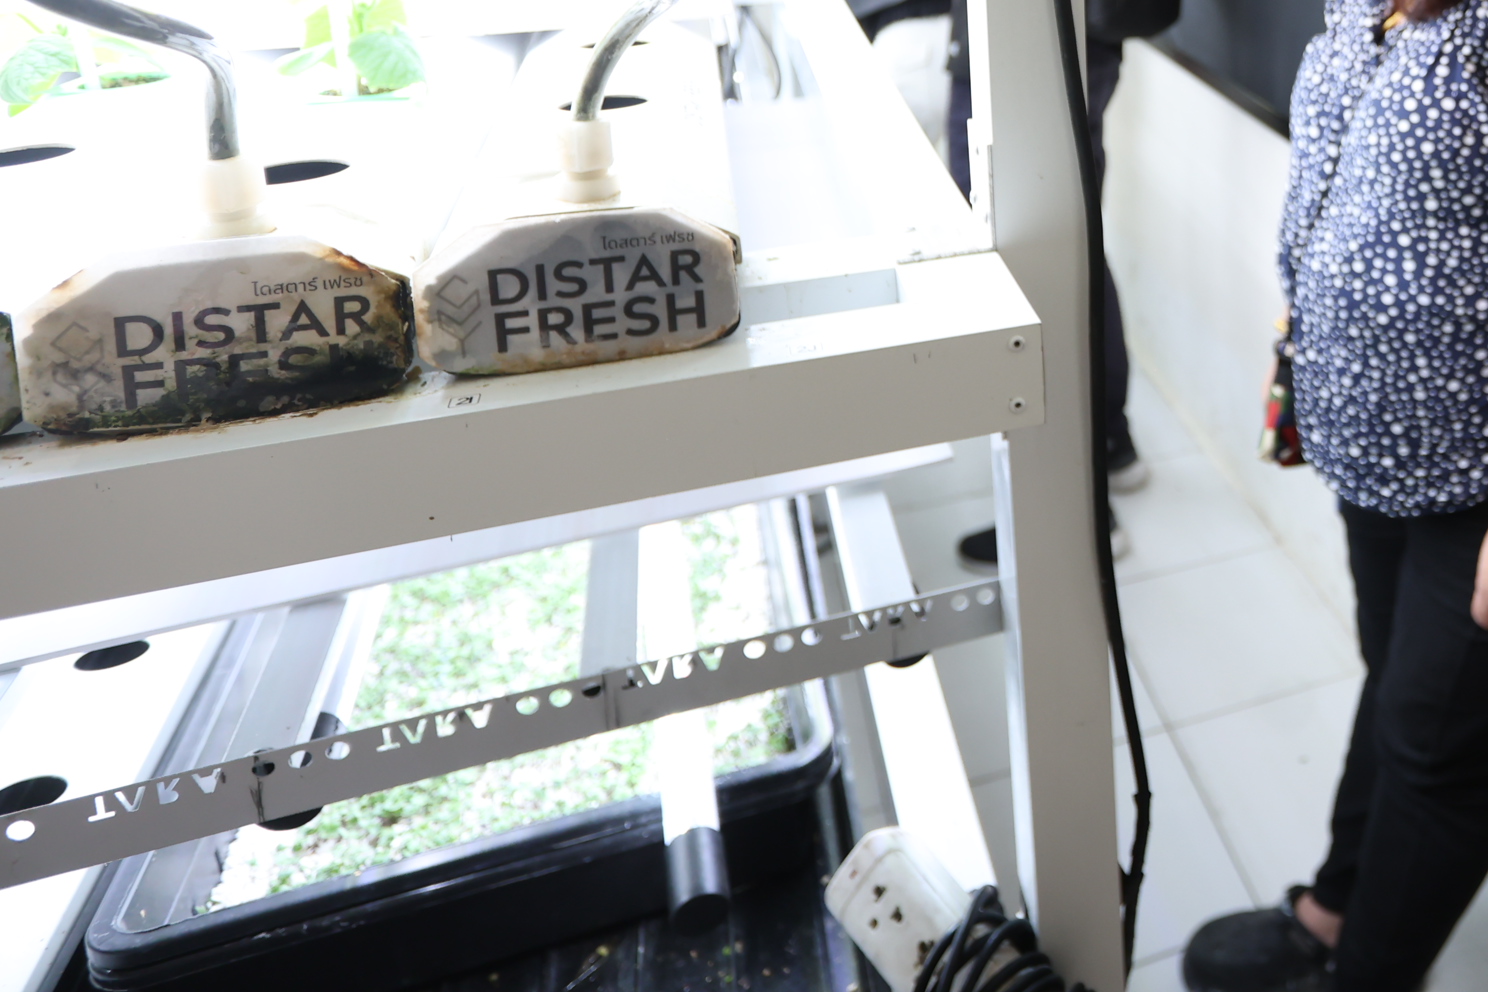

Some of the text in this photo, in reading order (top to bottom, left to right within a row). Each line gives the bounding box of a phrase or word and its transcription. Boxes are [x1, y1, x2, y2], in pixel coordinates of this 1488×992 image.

[601, 232, 656, 250] ไดสตาร์
[251, 277, 319, 296] ไดสตาร์
[487, 249, 703, 306] DISTAR
[113, 294, 374, 358] DISTAR
[494, 290, 706, 353] FRESH
